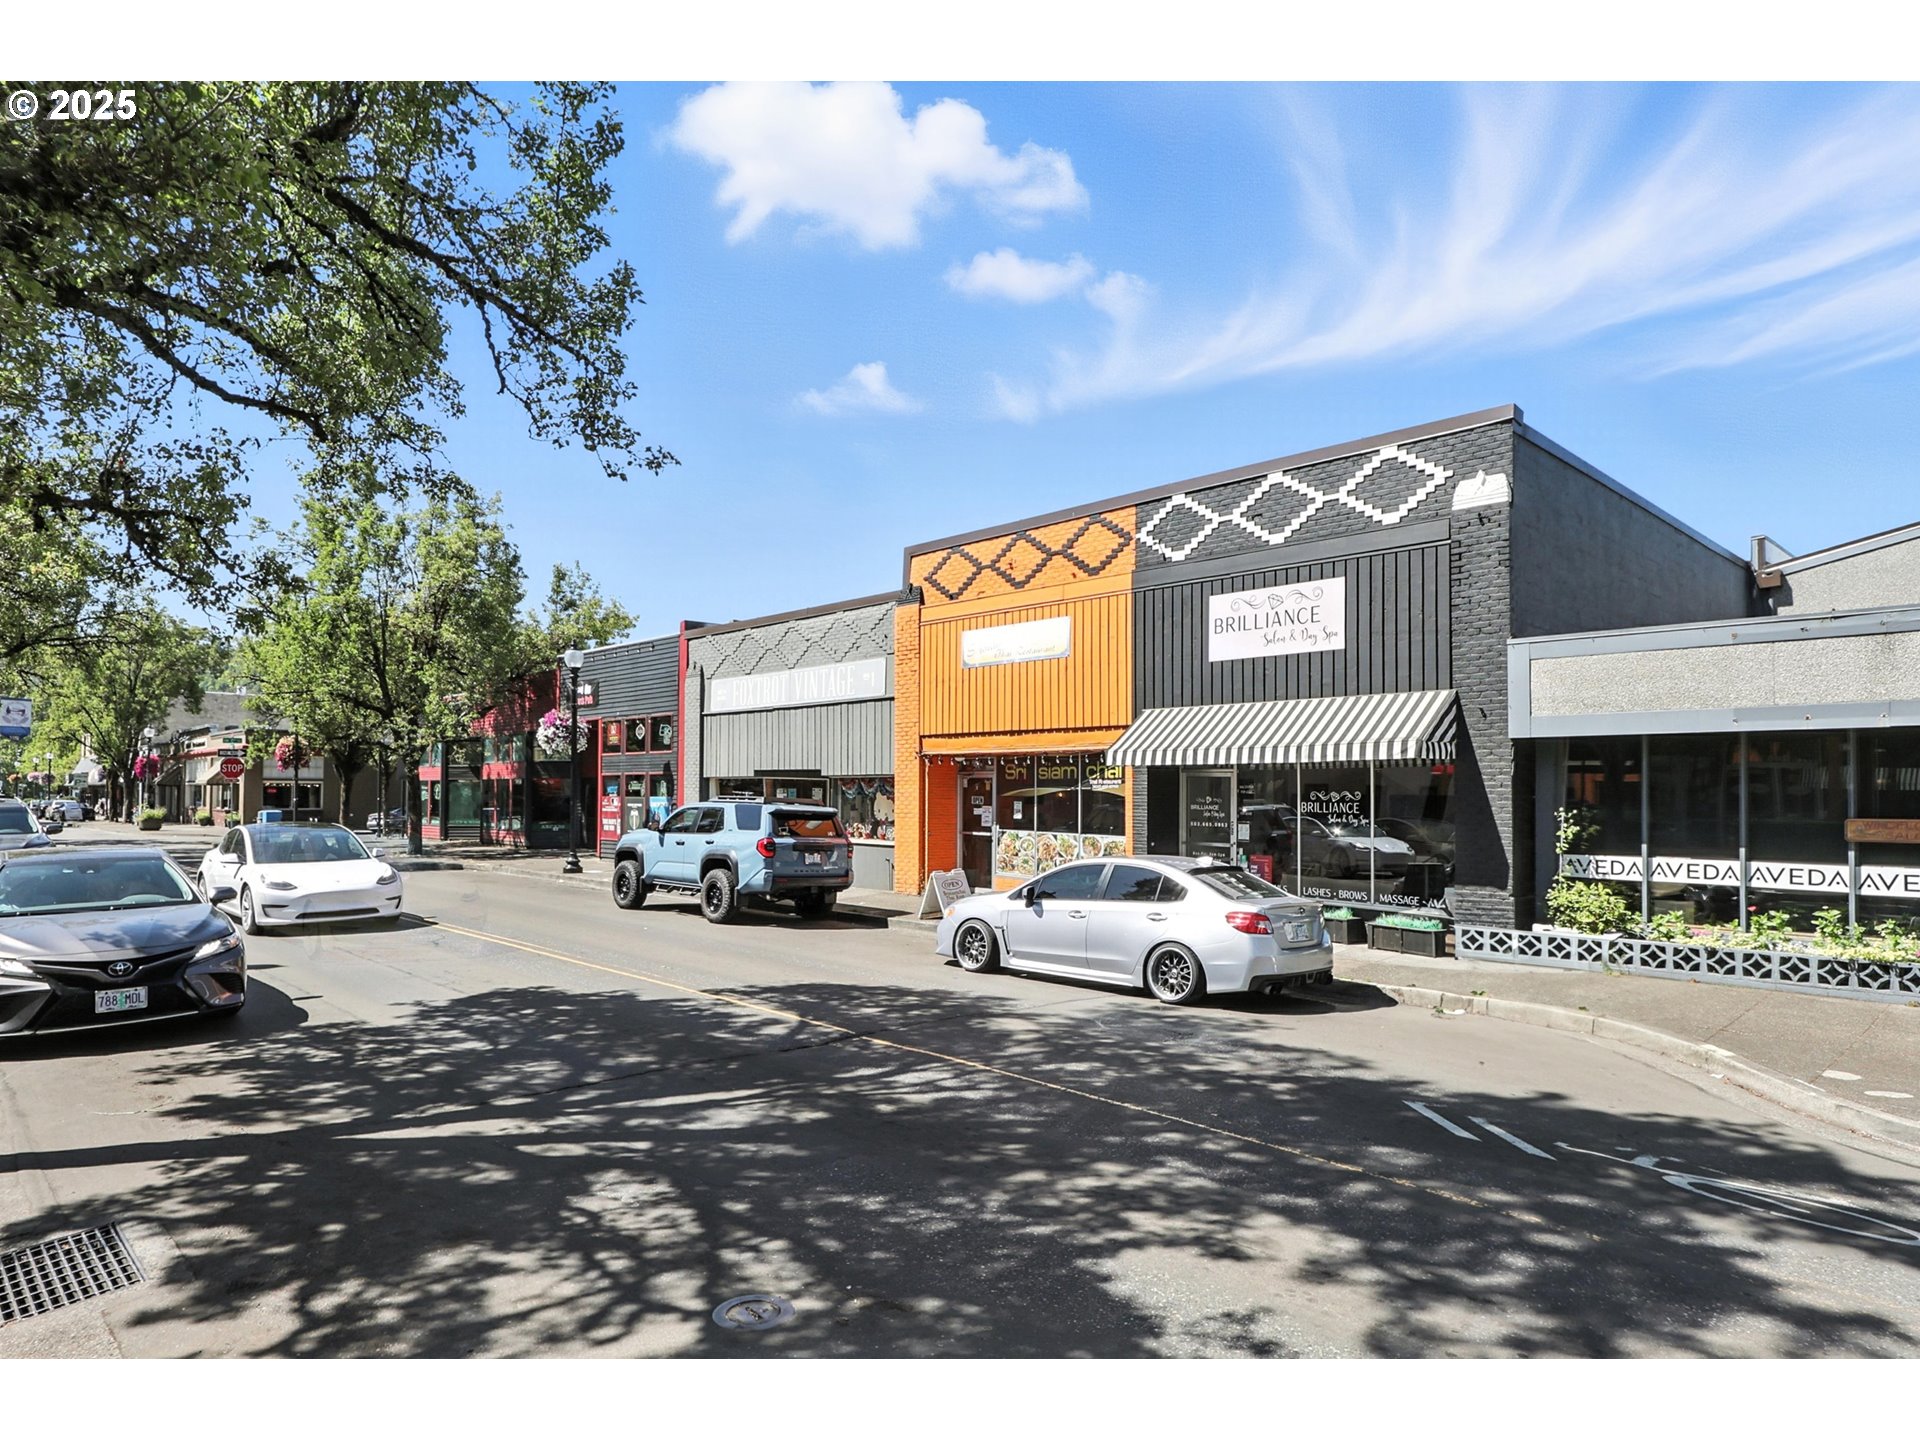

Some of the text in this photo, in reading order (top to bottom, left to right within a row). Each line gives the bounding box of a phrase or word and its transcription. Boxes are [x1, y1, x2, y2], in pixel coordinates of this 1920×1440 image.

[1214, 605, 1321, 635] BRILLIANCE
[1263, 624, 1338, 647] Salon & Day Spa
[732, 673, 789, 707] FOXTROT
[794, 665, 856, 699] VINTAGE
[221, 764, 243, 772] STOP
[1005, 762, 1027, 780] Sri
[1038, 762, 1077, 779] siam
[1301, 801, 1360, 813] BRILLIANCE
[1565, 858, 1642, 877] AVEDA
[1650, 862, 1740, 882] AVEDA
[943, 881, 960, 889] OPEN
[1748, 867, 1848, 887] AVEDA
[1303, 887, 1367, 901] LASHES BROWS
[1379, 894, 1420, 906] MASSAGE
[98, 992, 144, 1008] 788 MDL
